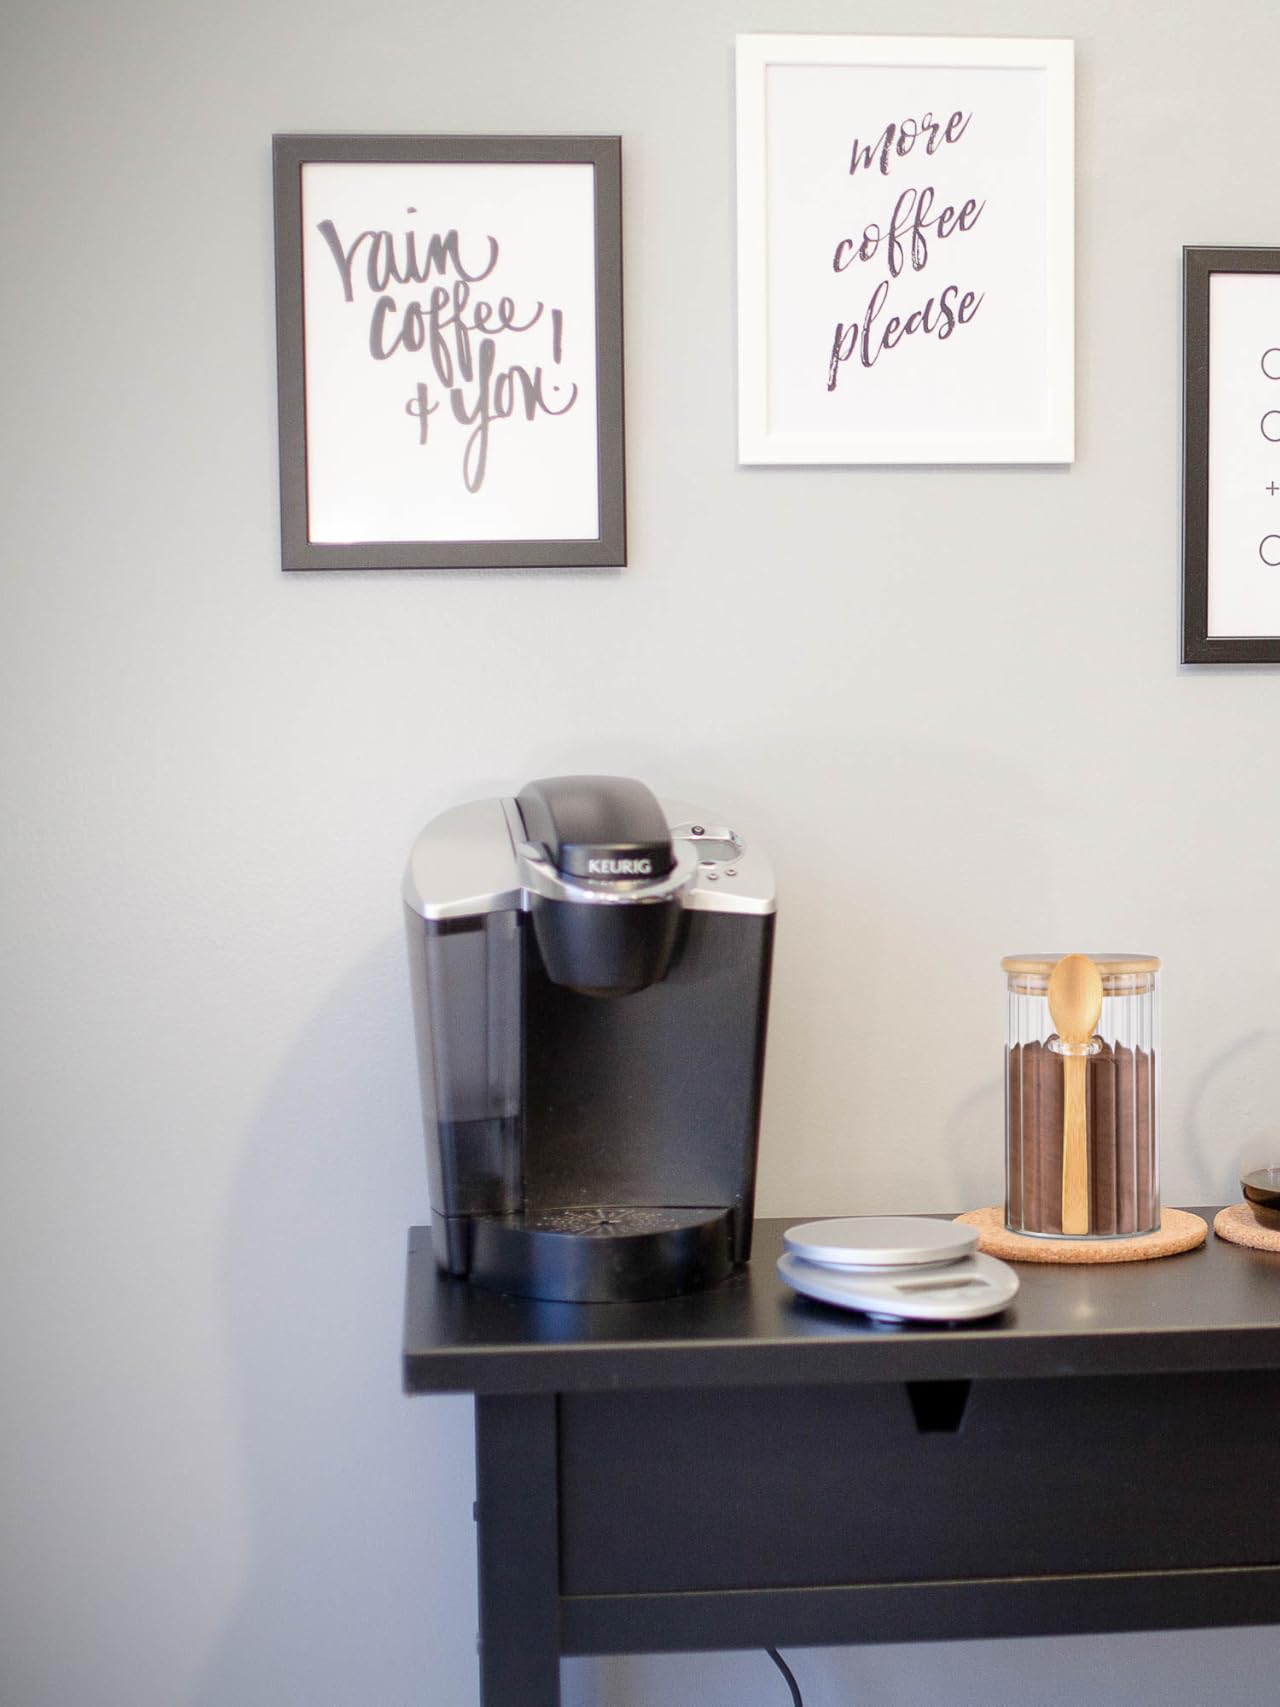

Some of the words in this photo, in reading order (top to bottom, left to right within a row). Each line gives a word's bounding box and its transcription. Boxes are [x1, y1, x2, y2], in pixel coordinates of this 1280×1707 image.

[848, 110, 973, 176] more
[317, 207, 499, 302] rain
[832, 187, 986, 278] coffee
[369, 280, 544, 388] coffee
[827, 280, 986, 392] please
[588, 858, 652, 874] KEURIG
